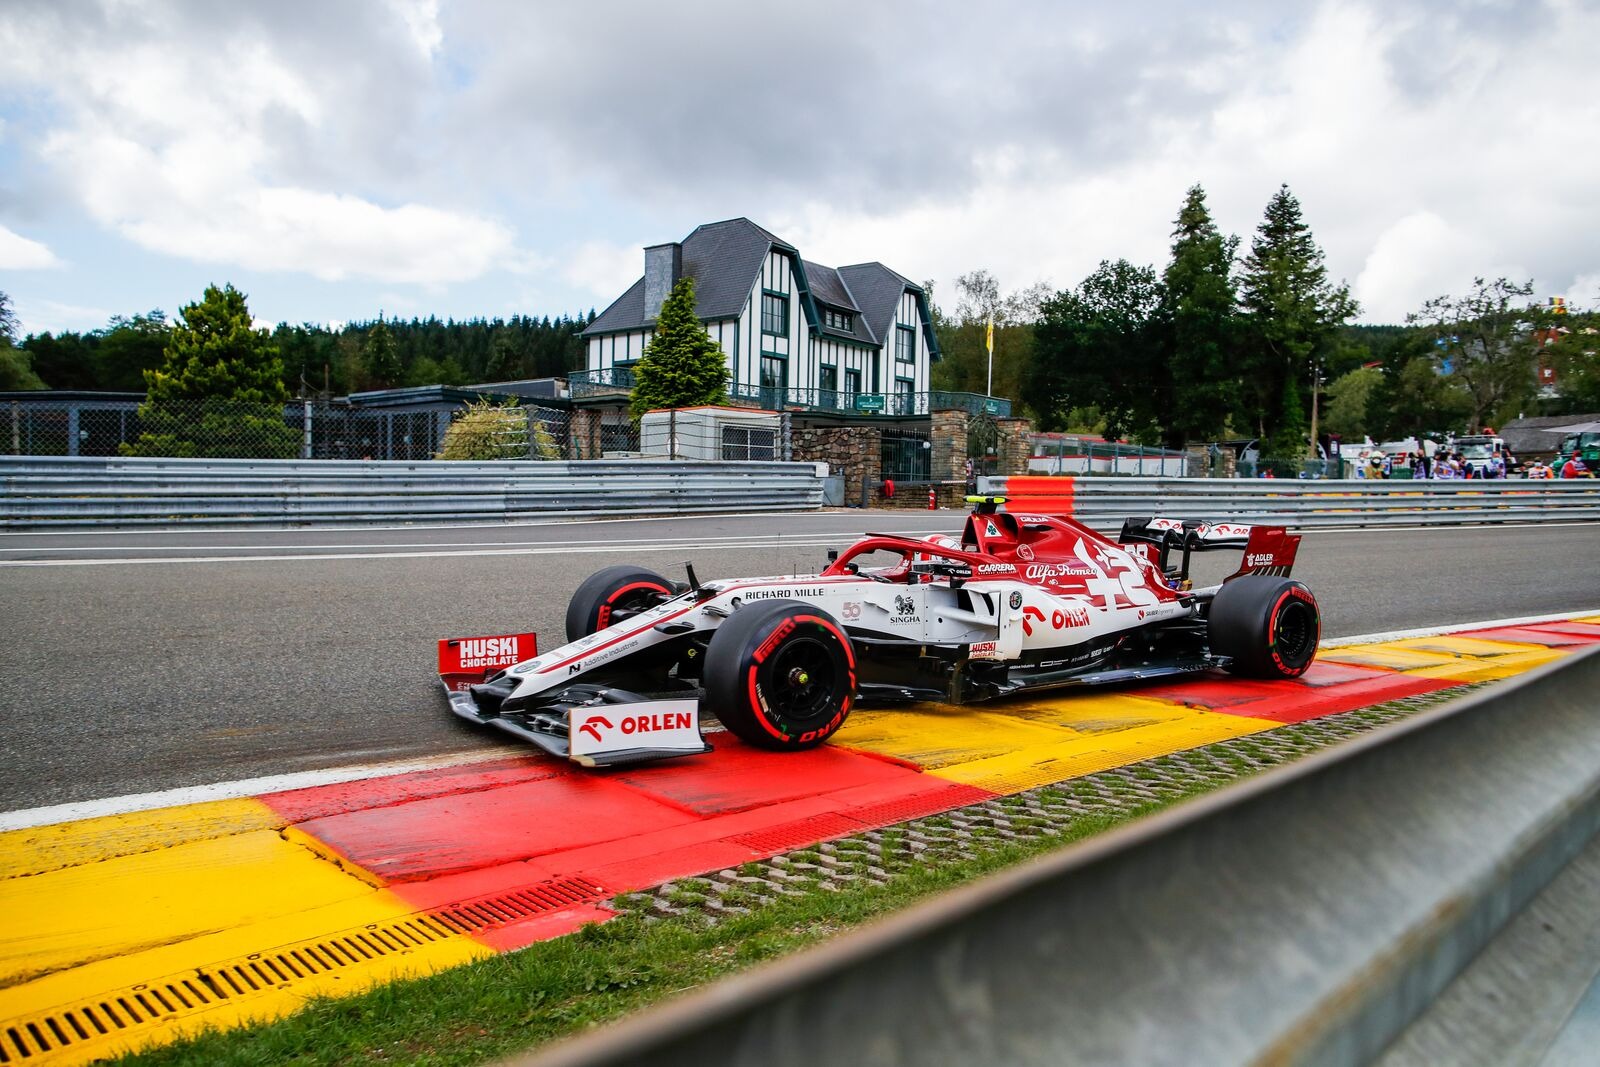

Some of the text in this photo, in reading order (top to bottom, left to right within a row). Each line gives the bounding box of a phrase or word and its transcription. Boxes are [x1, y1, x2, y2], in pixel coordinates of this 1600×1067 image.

[1254, 553, 1274, 562] ADLER
[978, 563, 1017, 573] CARRERA
[1025, 563, 1097, 584] Alfa Romeo
[745, 588, 825, 600] RICHARD MILLE
[842, 601, 861, 619] 50
[890, 615, 921, 624] SINGHA
[1052, 607, 1091, 630] ORLEN
[460, 636, 519, 659] HUSKI
[583, 653, 609, 668] Additive
[608, 639, 639, 657] Industries
[971, 642, 997, 652] HUSKI
[460, 655, 519, 669] CHOCOLATE
[620, 712, 692, 735] ORLEN
